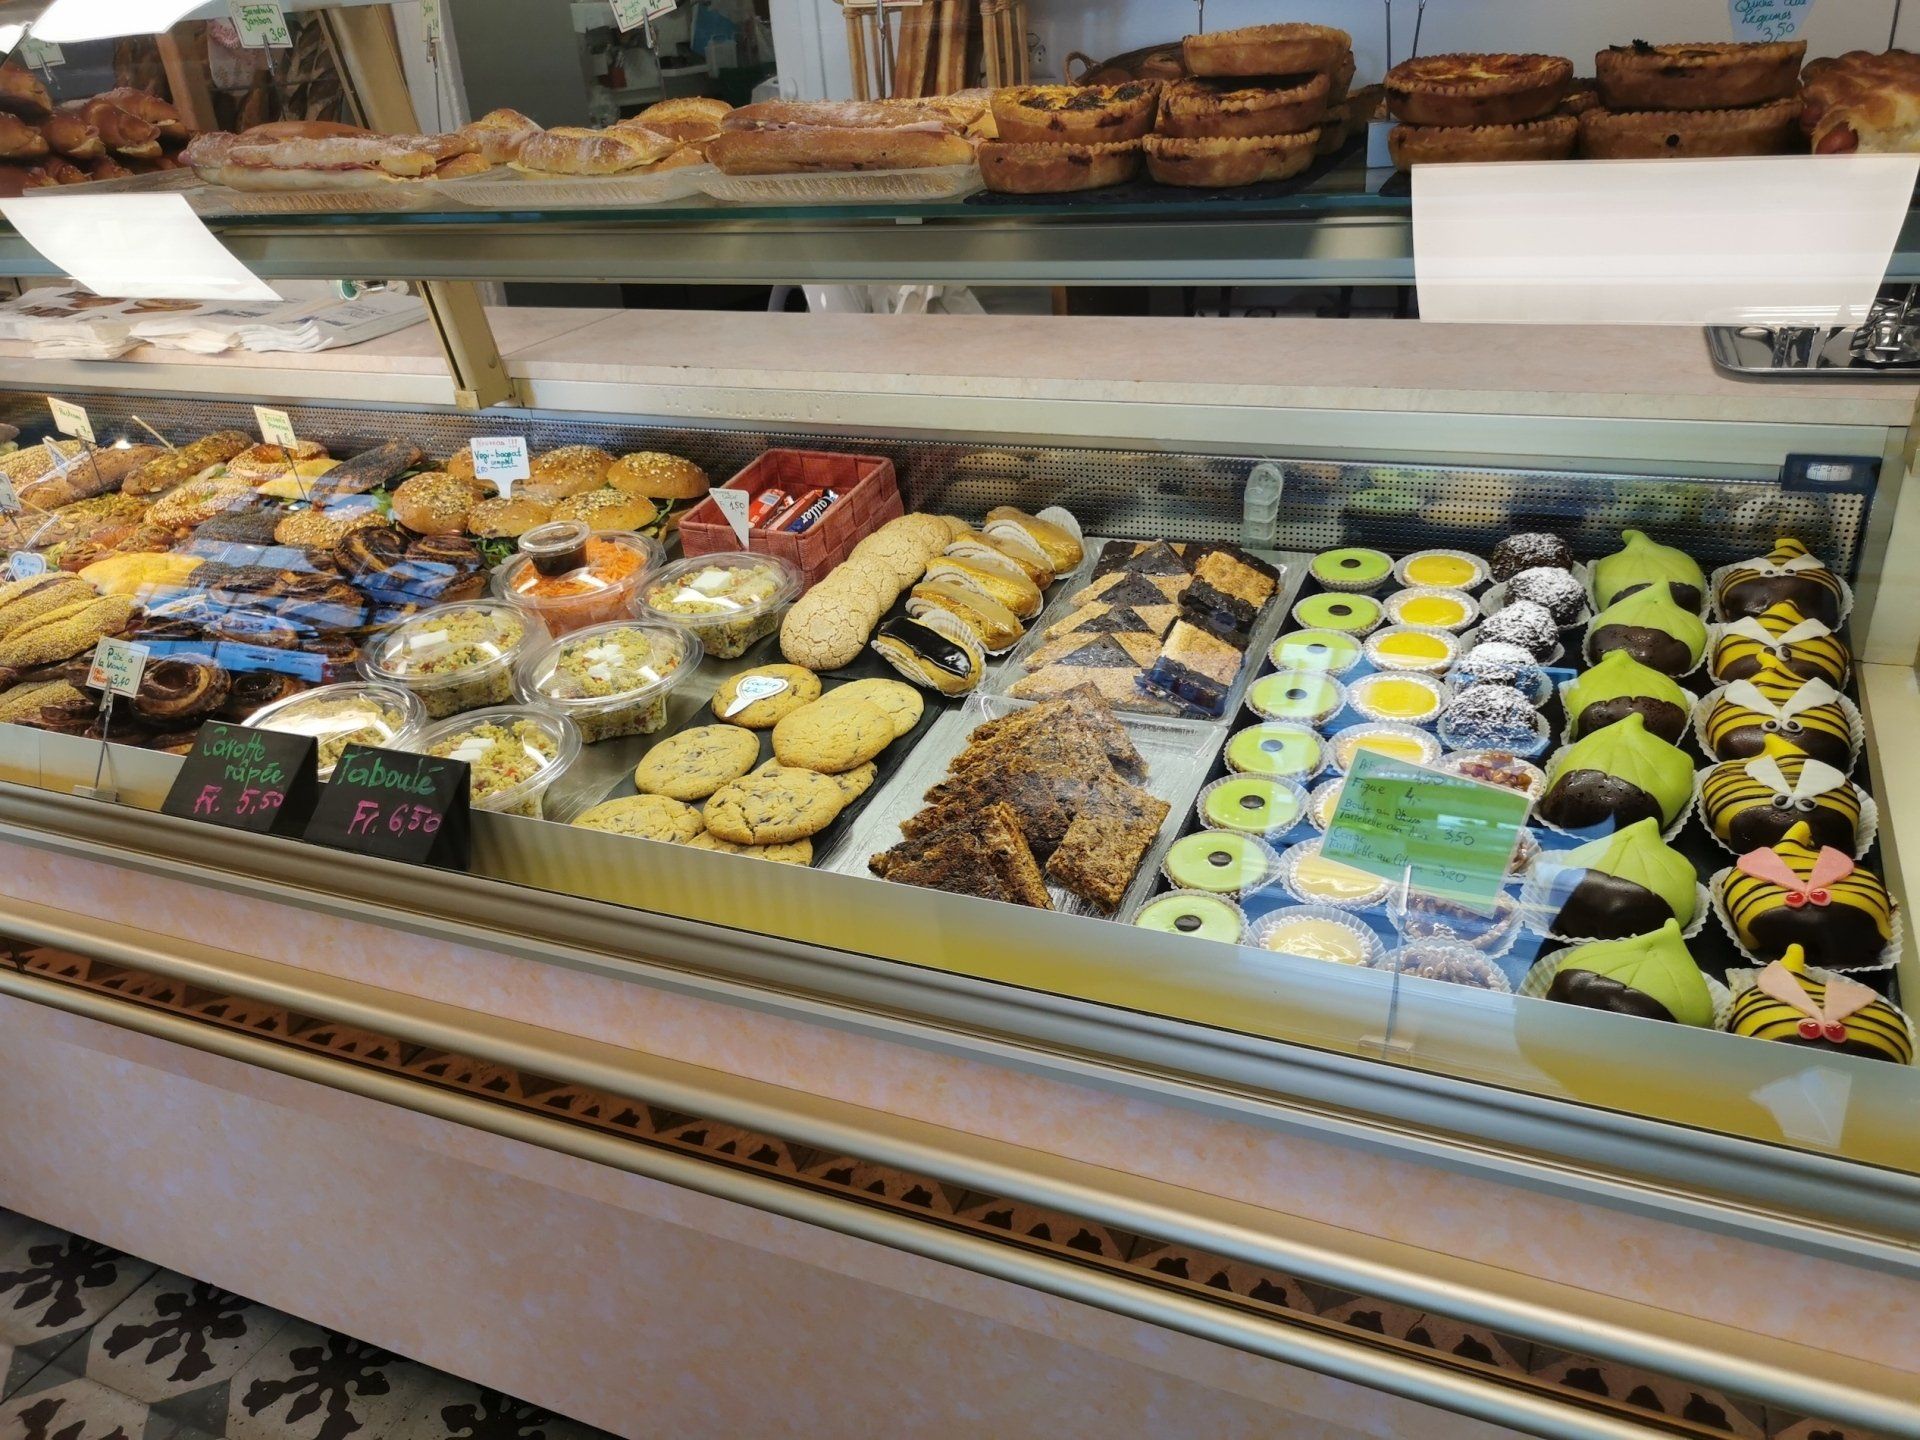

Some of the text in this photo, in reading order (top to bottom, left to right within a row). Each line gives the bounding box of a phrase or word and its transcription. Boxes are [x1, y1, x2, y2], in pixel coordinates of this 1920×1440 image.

[270, 27, 287, 42] 3,60
[1761, 22, 1796, 43] 3,50
[111, 674, 130, 688] 3,40
[203, 726, 266, 766] Carotte
[224, 759, 285, 791] râpée
[336, 750, 445, 795] Taboulé
[193, 785, 285, 815] Fr. 5,50
[347, 800, 442, 838] Fr. 6,50
[1443, 829, 1475, 847] 3,50
[1437, 866, 1467, 883] 3,20
